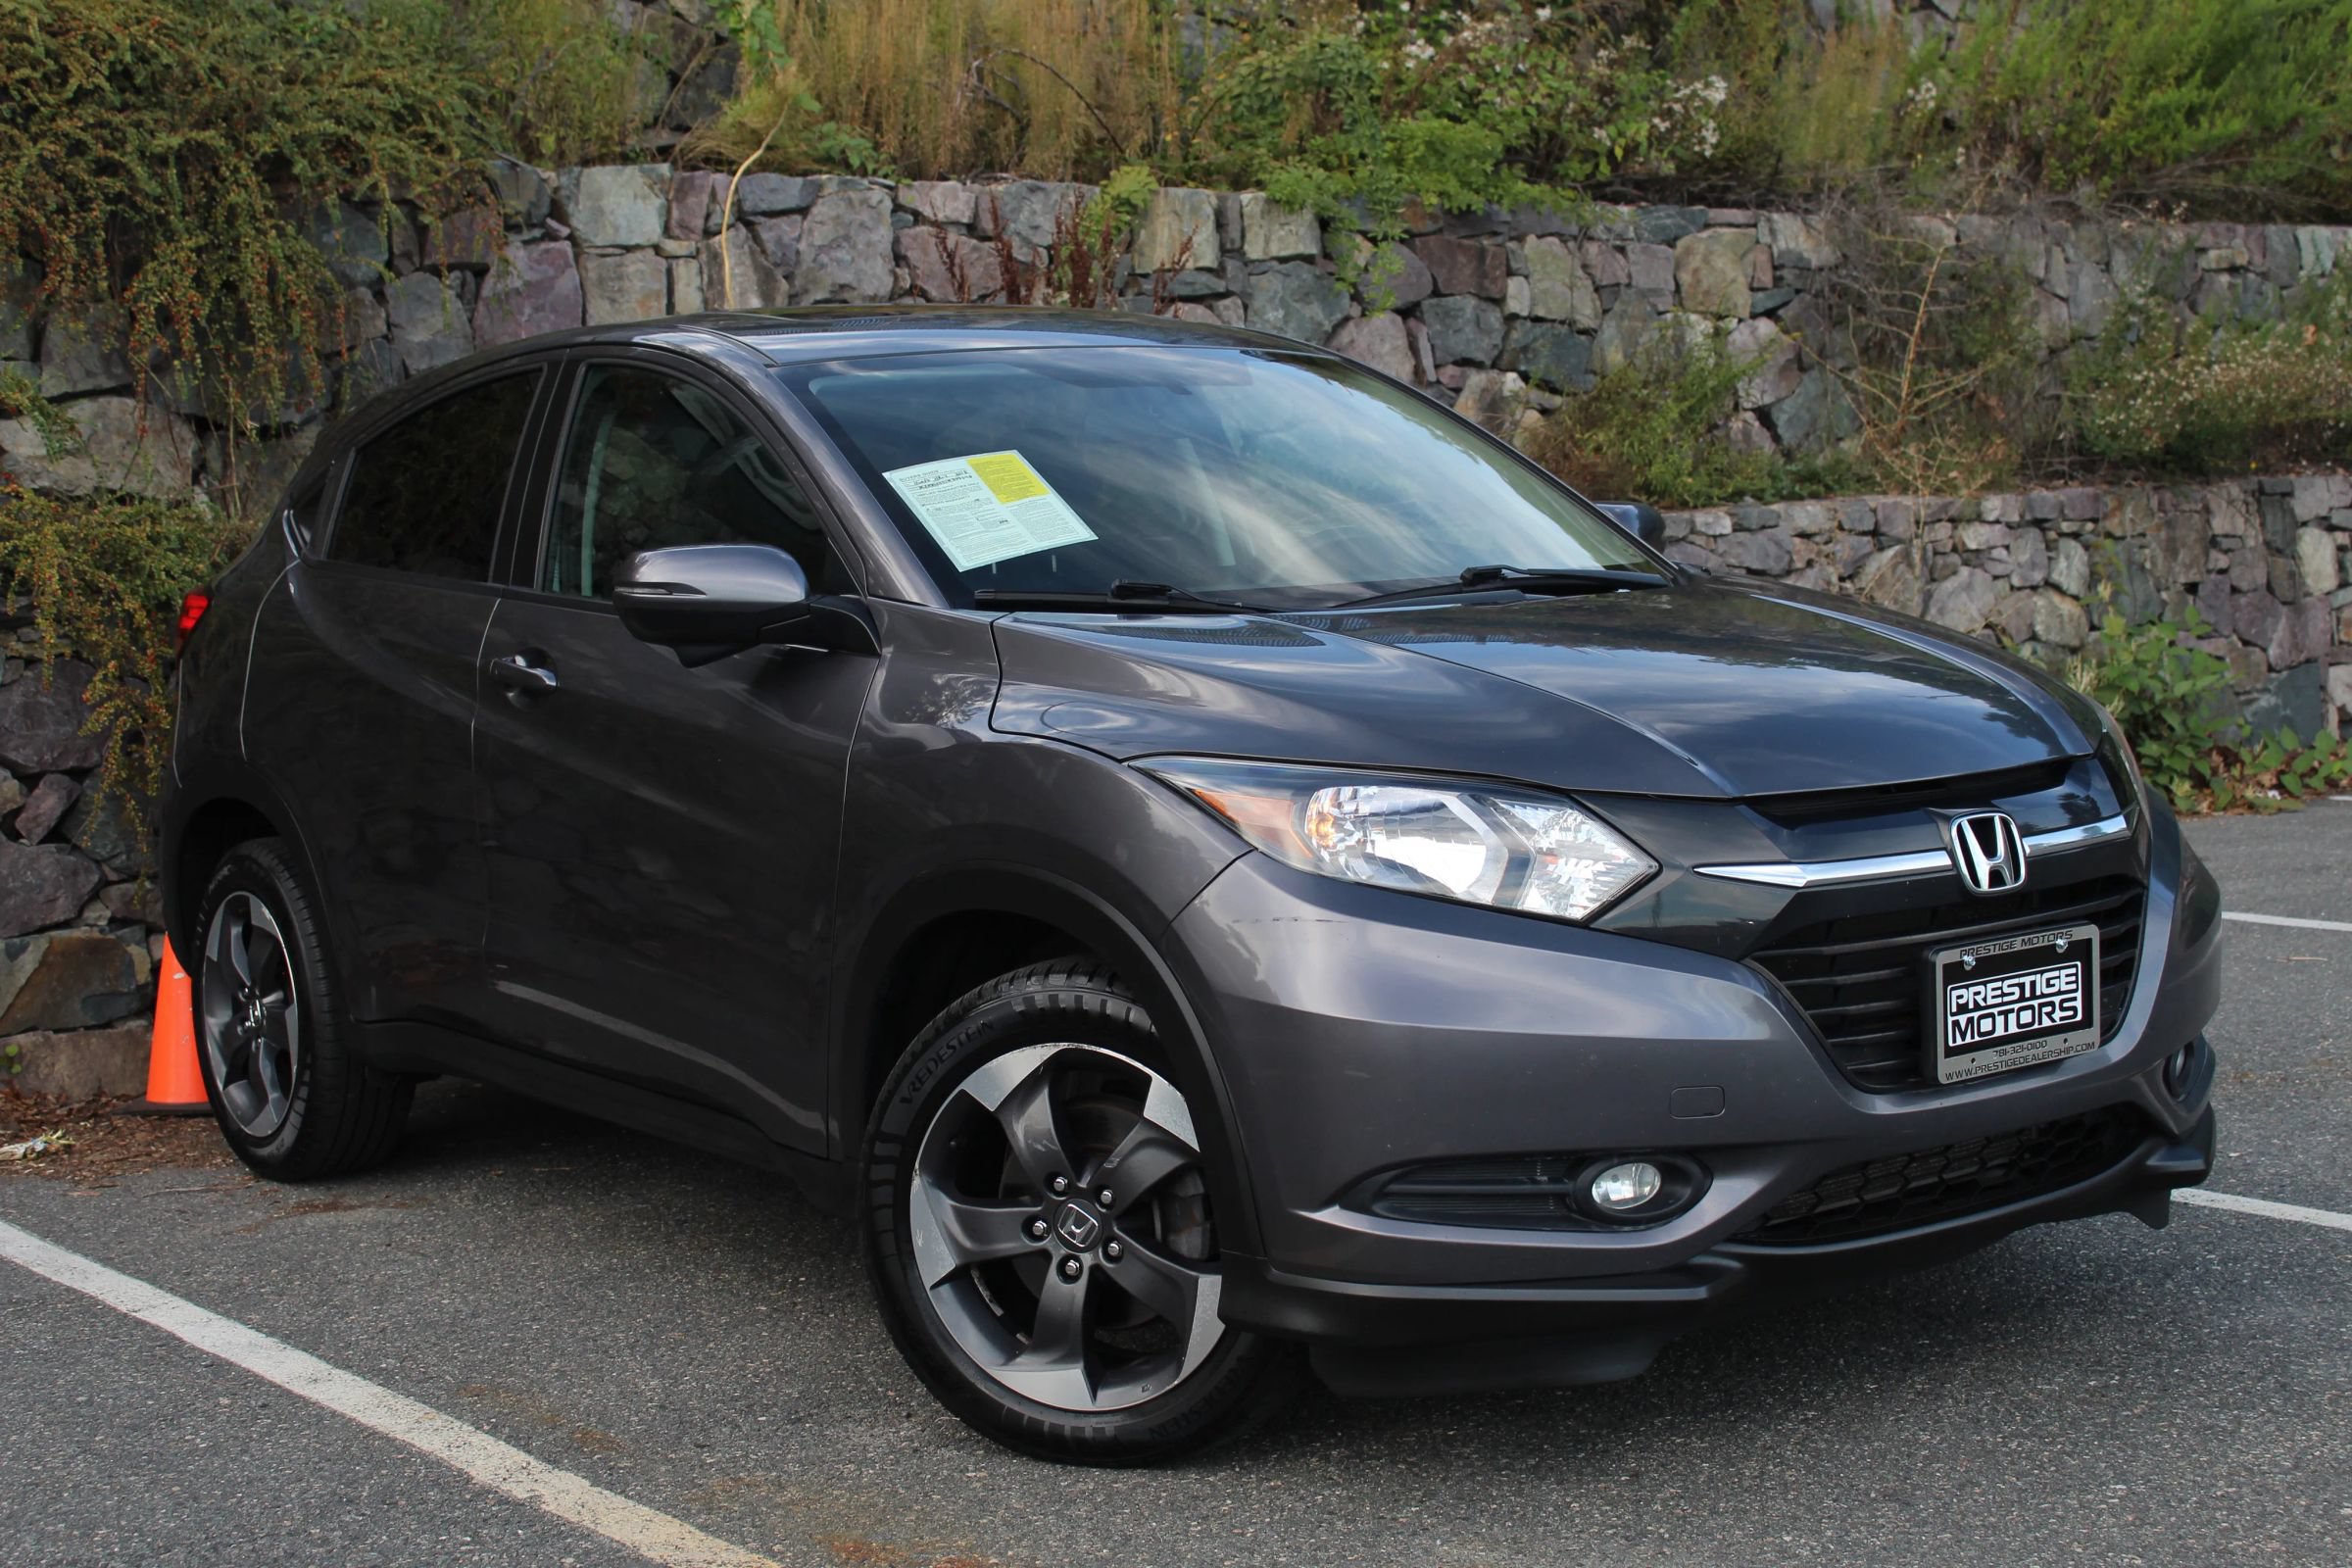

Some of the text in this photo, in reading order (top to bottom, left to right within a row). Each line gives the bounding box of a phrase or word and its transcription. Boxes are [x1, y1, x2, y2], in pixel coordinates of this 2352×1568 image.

[1960, 930, 2073, 958] PRESTIGE MOTORS
[1951, 967, 2077, 1013] PRESTIGE
[1951, 997, 2079, 1045] MOTORS
[900, 1021, 994, 1104] VREDESTEIN
[1945, 1042, 2095, 1082] WWW.PRESTIGEDEALERSHIP.COM
[1992, 1040, 2048, 1059] 781-321-0100
